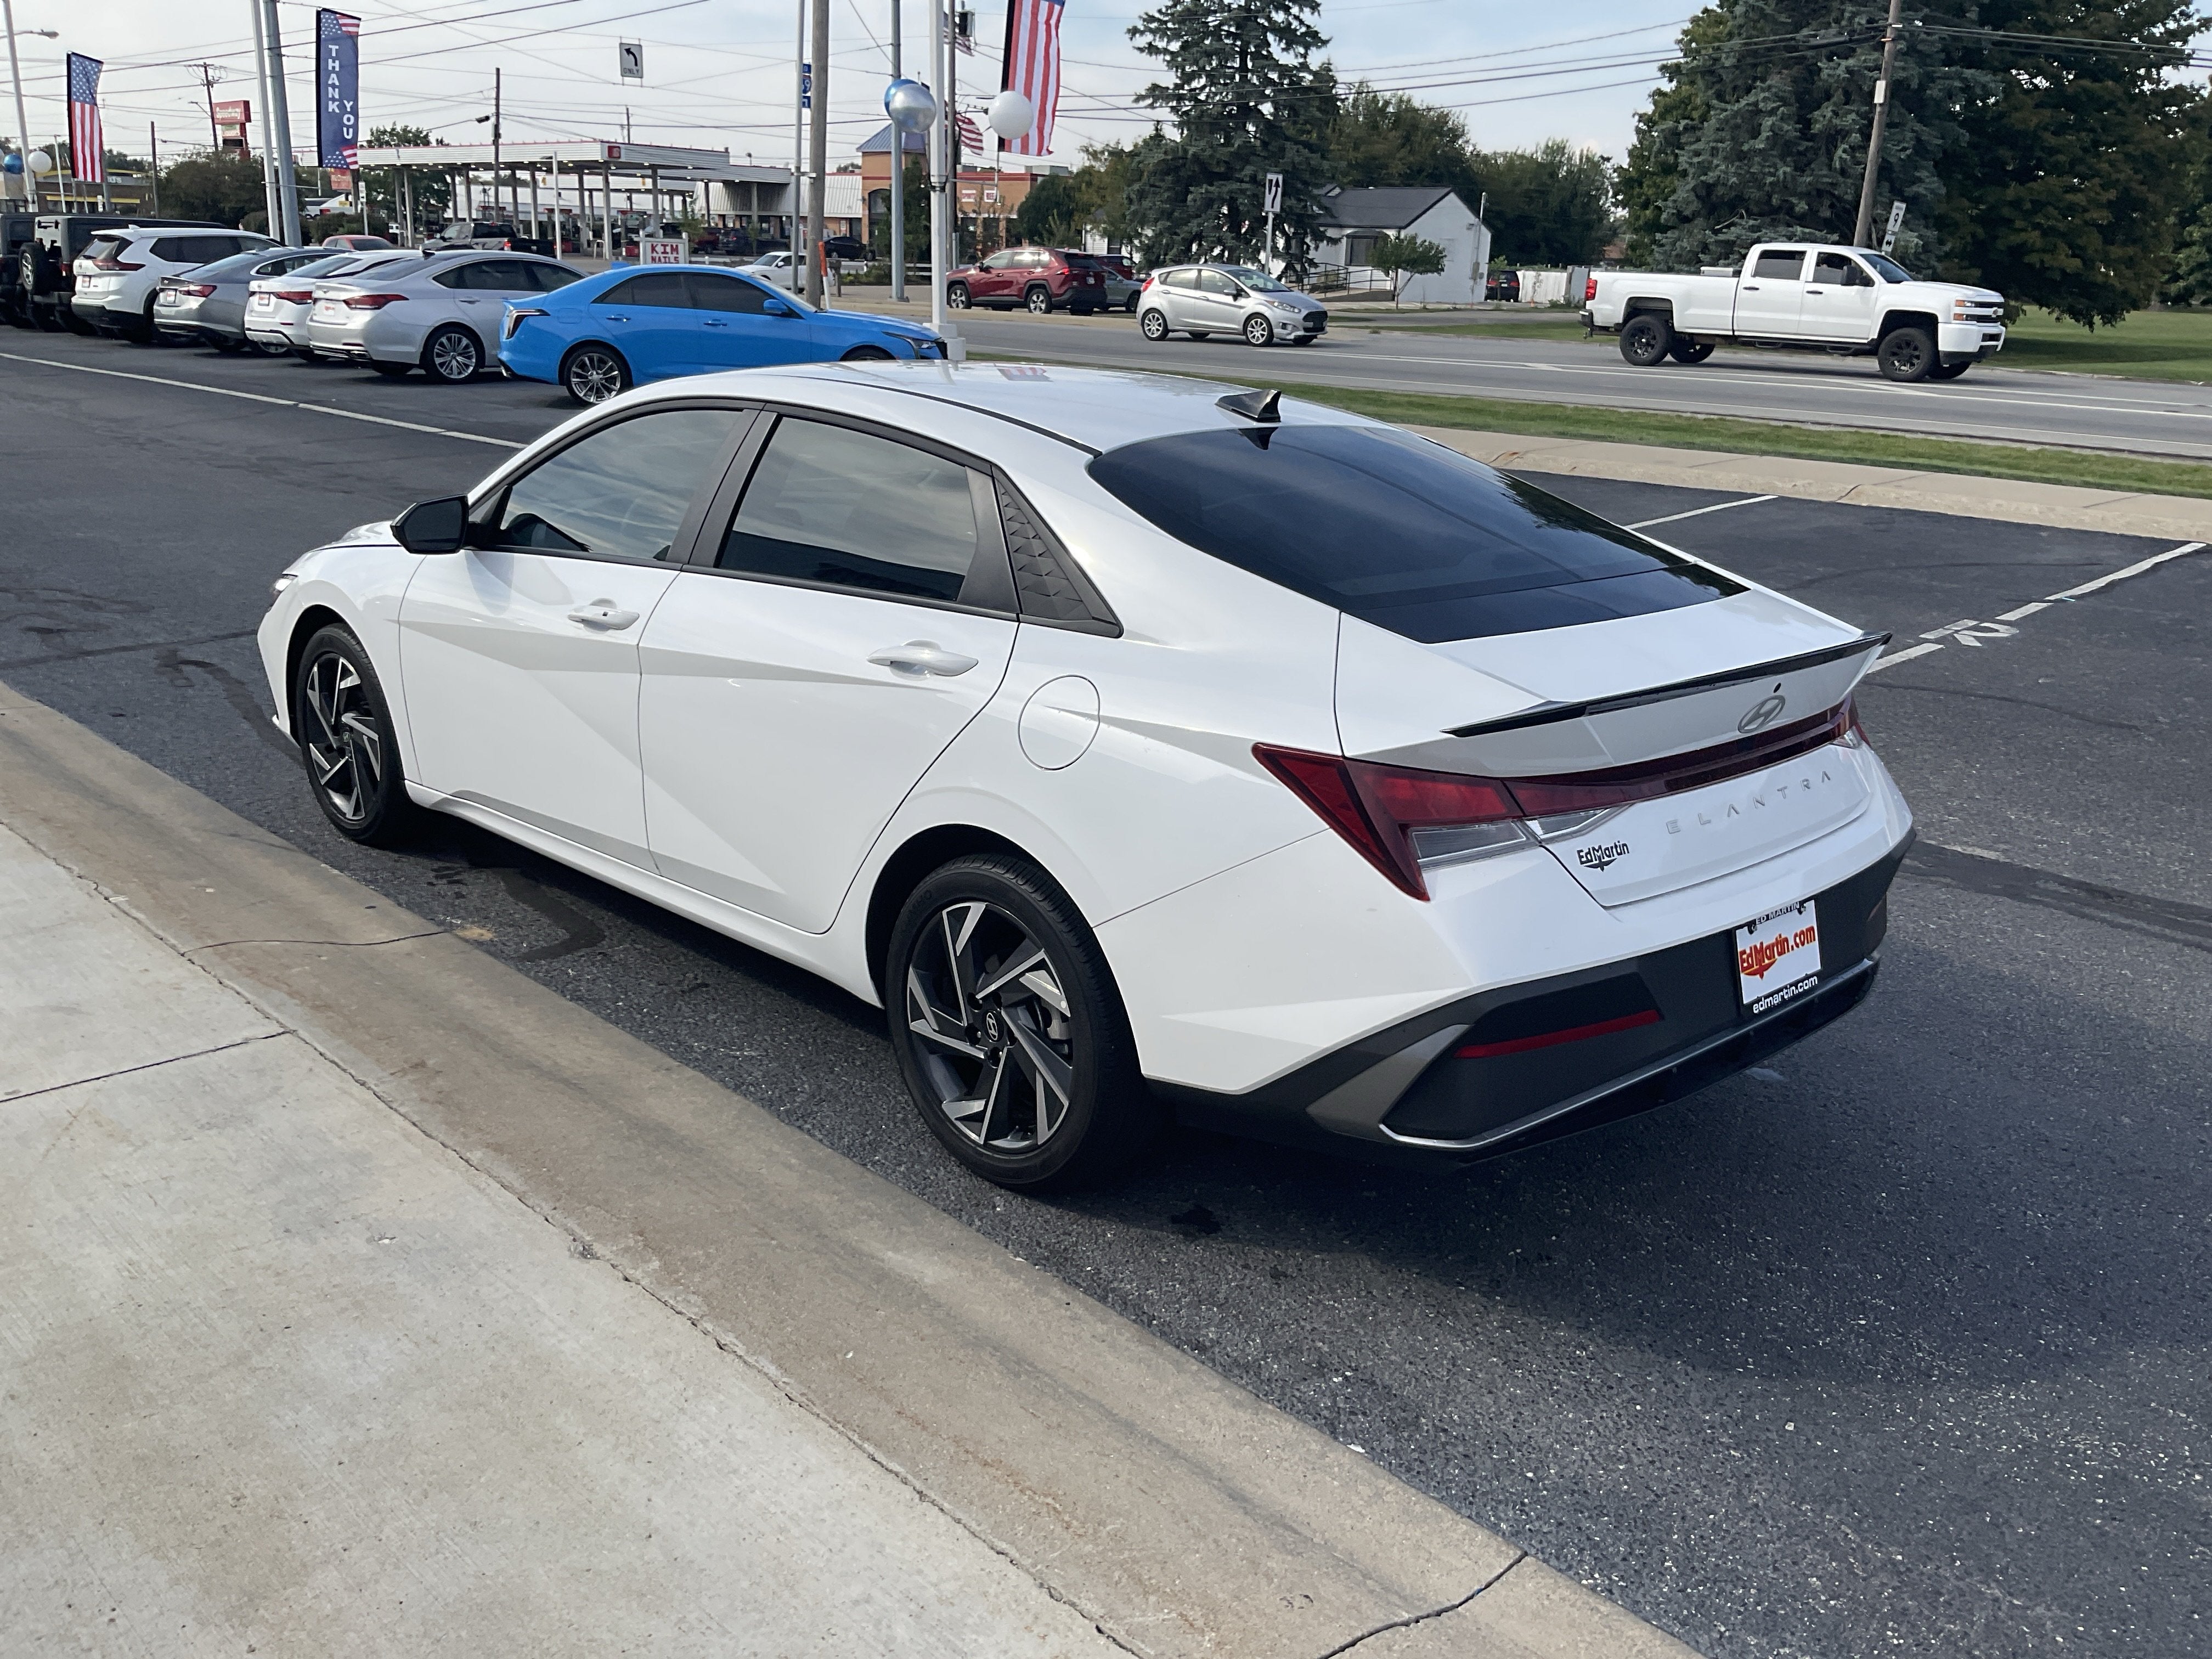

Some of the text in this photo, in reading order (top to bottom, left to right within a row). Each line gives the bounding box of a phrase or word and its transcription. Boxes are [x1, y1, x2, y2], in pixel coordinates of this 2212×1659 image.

[328, 44, 340, 113] THANK
[343, 99, 354, 139] YOU
[1892, 212, 1900, 228] 9
[651, 243, 680, 255] KIM
[651, 256, 680, 264] NAILS
[1666, 770, 1831, 834] ELANTRA
[1756, 901, 1800, 925] ED MARTIN
[1739, 925, 1816, 977] EdMartin.com
[1753, 975, 1818, 1014] edmartin.com
